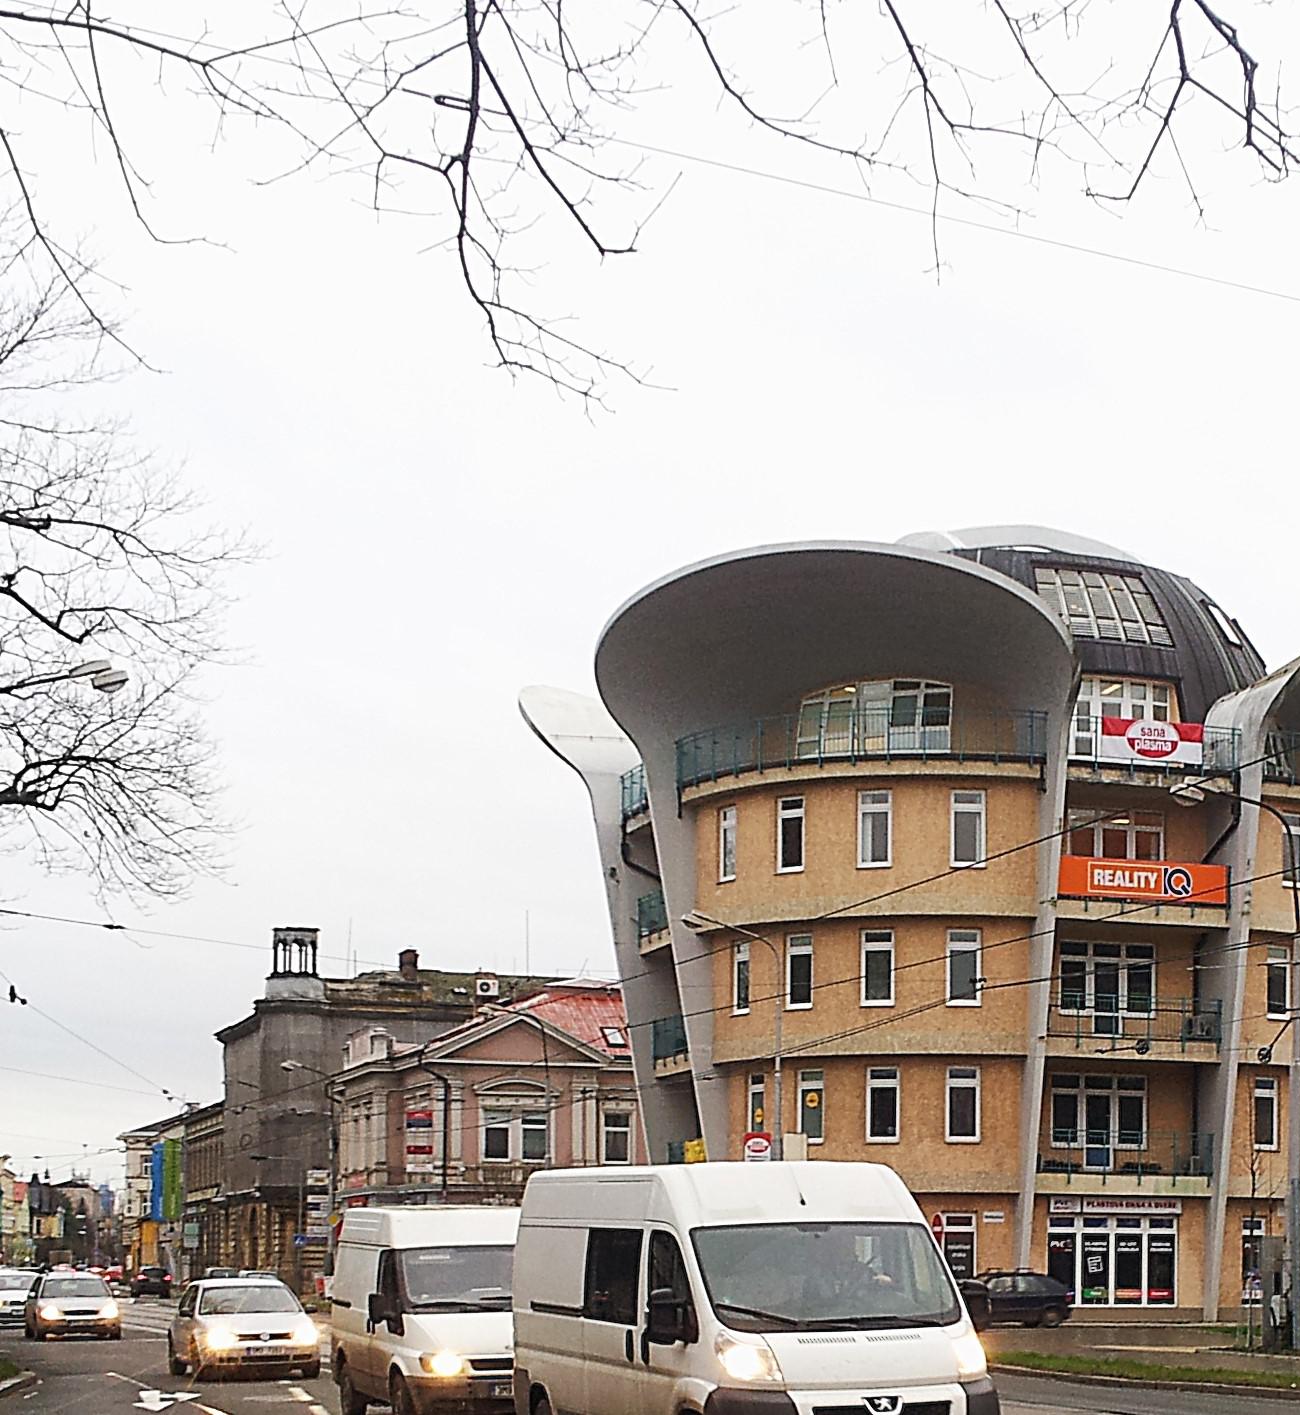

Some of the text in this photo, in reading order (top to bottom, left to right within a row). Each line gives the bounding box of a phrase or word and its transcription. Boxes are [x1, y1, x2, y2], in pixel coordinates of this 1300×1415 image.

[1141, 726, 1166, 738] sana
[1135, 738, 1171, 752] plasma
[1093, 866, 1192, 897] REALITY IQ
